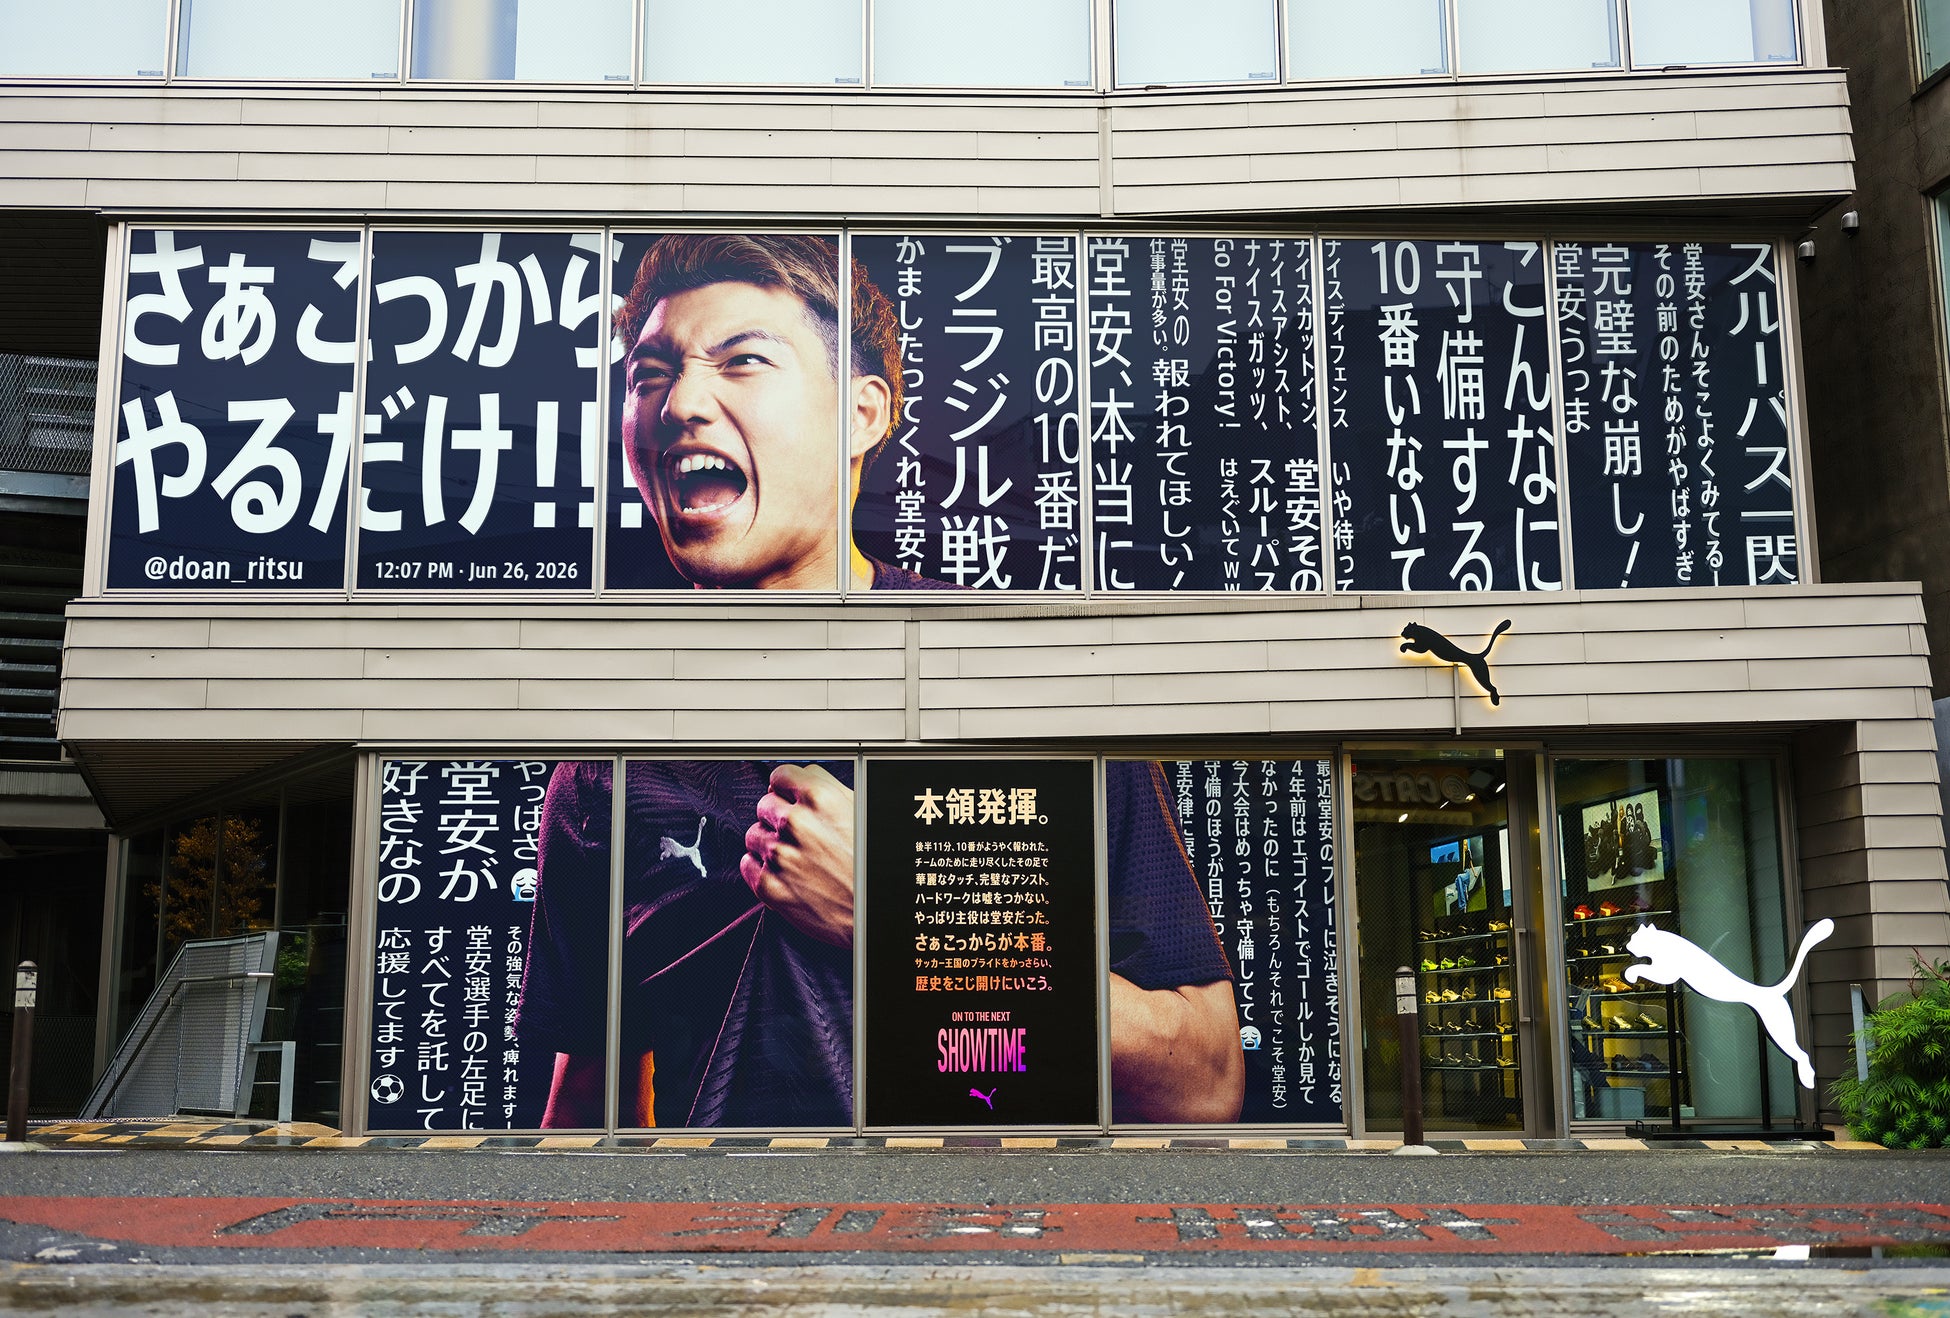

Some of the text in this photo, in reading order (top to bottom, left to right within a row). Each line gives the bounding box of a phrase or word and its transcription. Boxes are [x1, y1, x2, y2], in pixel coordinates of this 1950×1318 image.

[122, 230, 627, 368] さぁこっから
[1149, 238, 1168, 351] 仕事量が多い。
[1170, 238, 1190, 346] 堂安の
[1214, 239, 1241, 428] Go For Victory!
[1244, 239, 1268, 431] ナイスガッツ、
[1269, 240, 1293, 431] ナイスアシスト、
[1294, 240, 1317, 431] ナイスカットイン、
[1325, 240, 1349, 428] ナイスディフェンス
[1554, 242, 1591, 433] 堂安うっま
[940, 236, 1013, 590] ブラジル戦
[1031, 237, 1079, 590] 最高の10番だ
[1089, 238, 1135, 590] 堂安、本当に
[1371, 241, 1427, 590] 10番いないて
[1435, 241, 1493, 590] 守備する
[1503, 241, 1563, 590] こんなに
[1592, 243, 1644, 588] 完璧な崩し!
[1653, 244, 1695, 582] その前のためがやばすぎ
[1729, 243, 1796, 585] スルーパス一閃
[144, 556, 303, 583] @doan_ritsu
[375, 562, 421, 579] 12:07
[427, 562, 453, 579] PM
[468, 562, 496, 580] Jun
[503, 562, 529, 581] 26,
[536, 562, 578, 579] 2026
[1249, 459, 1280, 590] スルーパス
[1285, 458, 1323, 590] 堂安その
[1333, 462, 1355, 590] いや待って
[378, 762, 428, 904] 好きなの
[437, 762, 499, 902] 堂安が
[914, 788, 1048, 825] 本領発揮。
[915, 857, 1048, 868] チームのために走り尽くしたその足で
[1176, 761, 1196, 868] 堂安律に
[1204, 761, 1224, 945] 守備のほうが目立っ
[1261, 761, 1280, 877] なかったのに
[914, 910, 1049, 925] やっぱり主役は堂安だった。
[915, 873, 1049, 886] 華麗なタッチ、完璧なアシスト。
[915, 892, 1049, 904] ハードワークは嘘をつかない。
[915, 932, 1052, 951] さぁこっからが本番。
[1232, 761, 1254, 1021] 今大会はめっちゃ守備してて
[375, 928, 411, 1068] 応援してます
[417, 926, 452, 1130] すべてを託して
[460, 925, 492, 1129] 堂安選手の左足に
[915, 976, 1053, 991] 歴史をこじ開けにいこう。
[937, 1028, 1027, 1072] SHOWTIME
[952, 1012, 1010, 1021] ON TO THE NEXT
